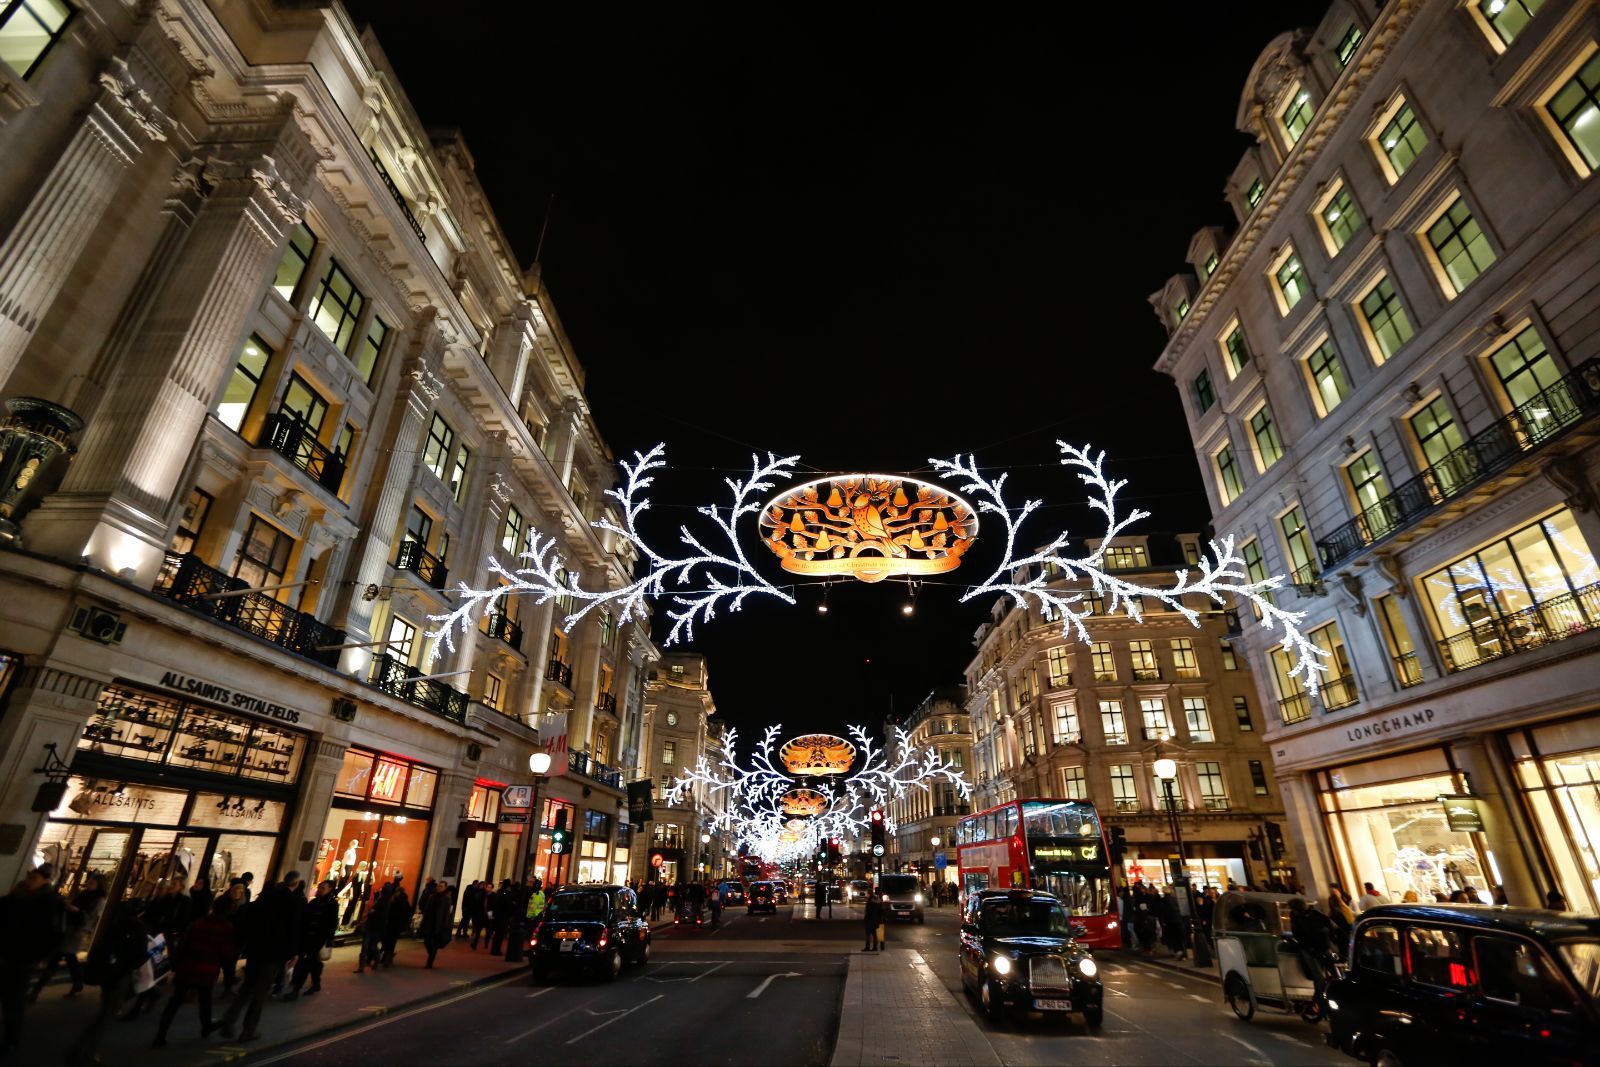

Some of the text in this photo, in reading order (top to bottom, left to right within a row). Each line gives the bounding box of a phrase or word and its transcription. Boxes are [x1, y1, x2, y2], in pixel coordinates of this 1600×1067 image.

[159, 671, 300, 724] ALLSAINTS SPITALFIELDS
[1347, 708, 1434, 742] LONGCHAMP
[92, 793, 156, 810] ALLSAINTS
